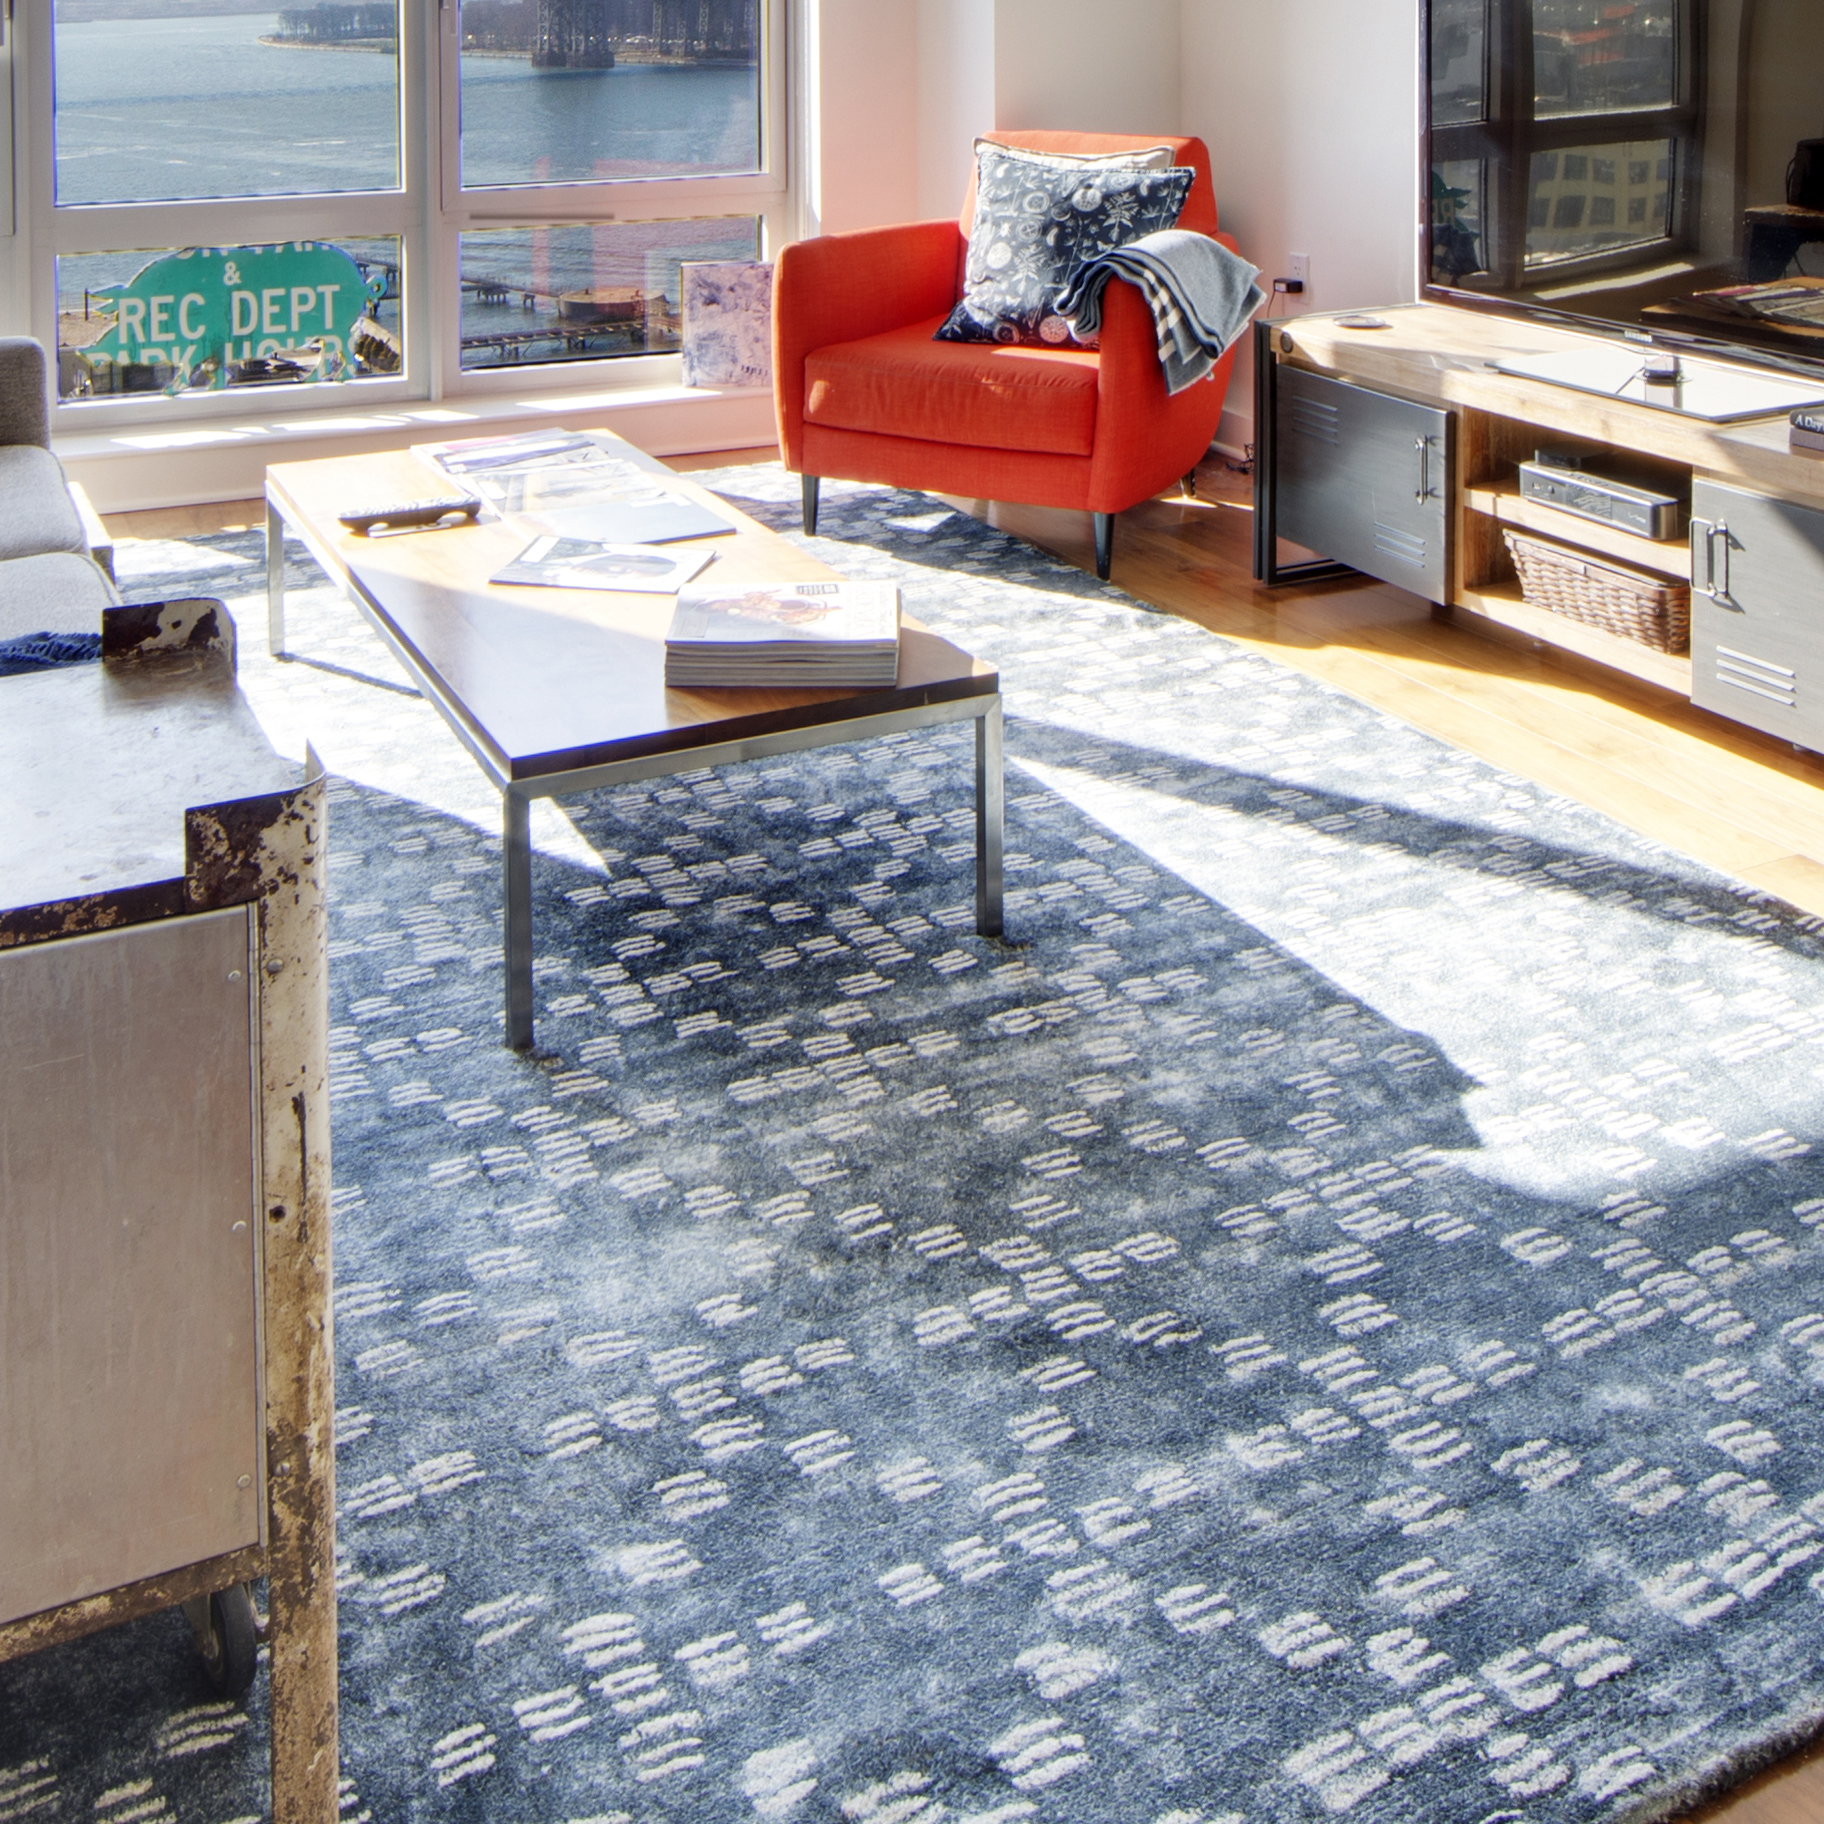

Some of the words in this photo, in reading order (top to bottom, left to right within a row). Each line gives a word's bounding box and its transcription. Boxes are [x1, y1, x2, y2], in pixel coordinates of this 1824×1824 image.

[223, 261, 242, 286] &
[118, 293, 206, 344] REC
[231, 284, 341, 337] DEPT
[1795, 415, 1803, 426] A
[1805, 417, 1823, 432] Day
